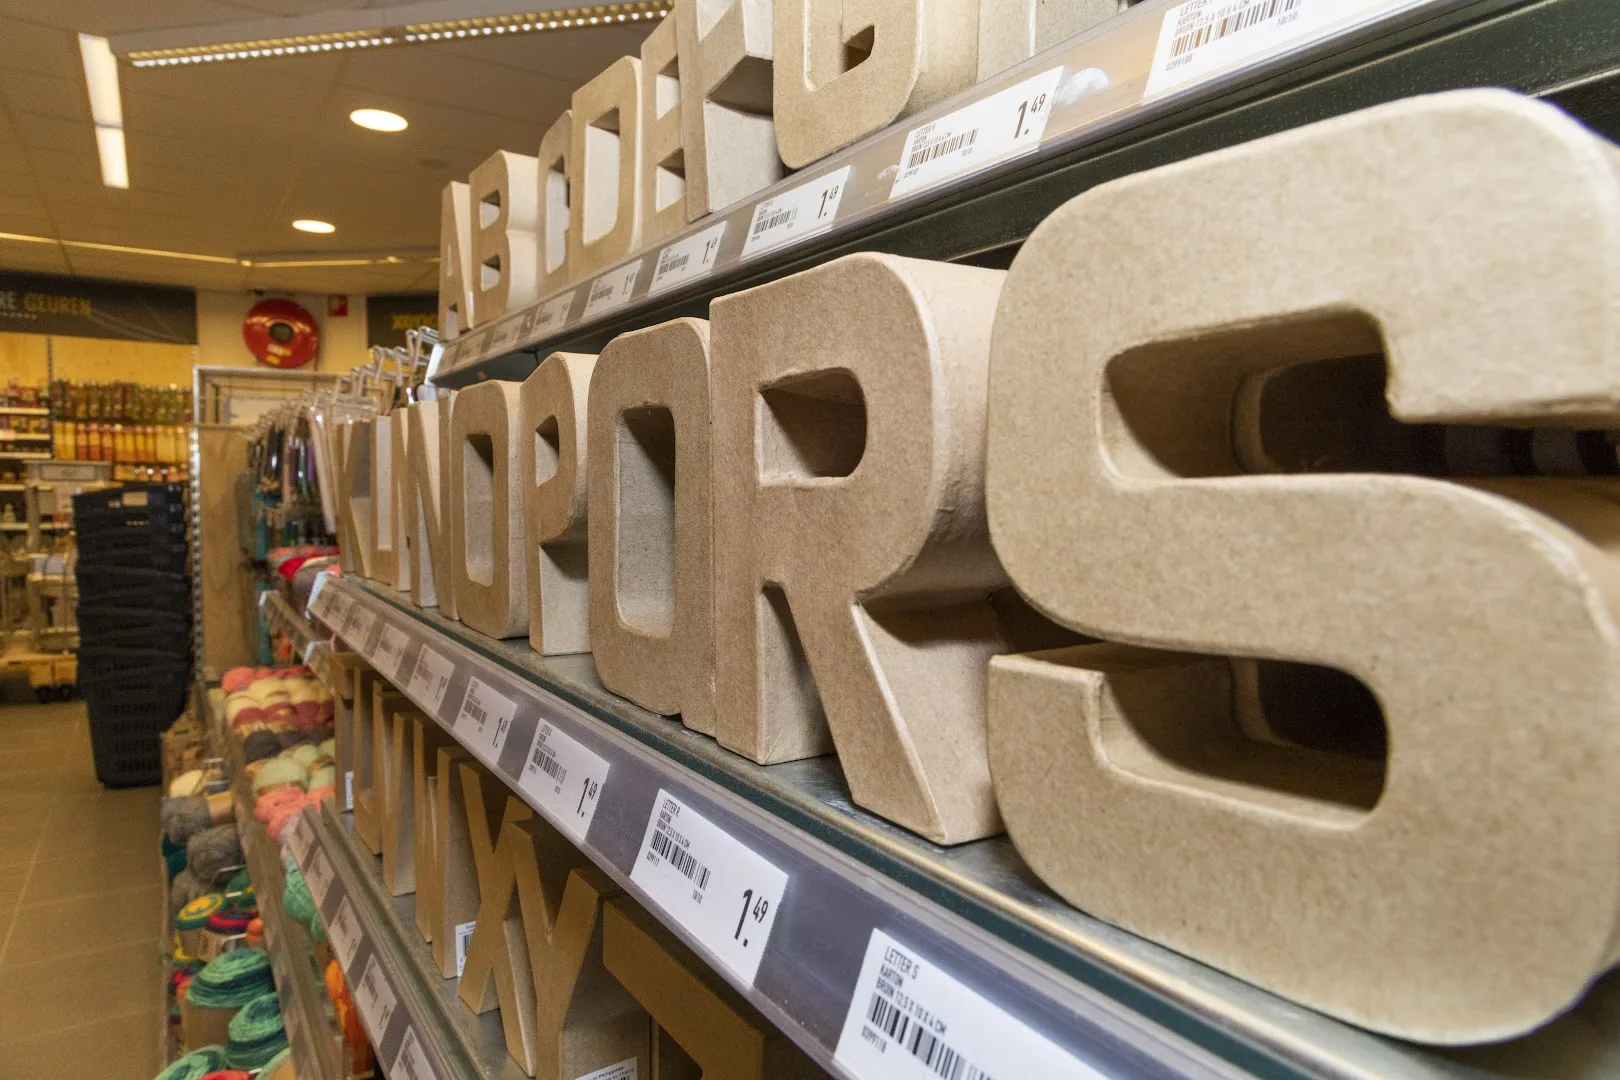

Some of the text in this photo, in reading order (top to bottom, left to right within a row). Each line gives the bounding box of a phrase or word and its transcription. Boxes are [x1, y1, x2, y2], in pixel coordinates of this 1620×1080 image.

[1174, 22, 1195, 36] BRUIN
[1211, 12, 1216, 20] X
[1217, 9, 1226, 19] 10
[1177, 9, 1202, 26] KARTON
[1276, 11, 1298, 27] 10/10
[1014, 93, 1046, 139] 1.49
[915, 125, 932, 138] LETTER
[818, 185, 839, 219] 1.49
[709, 252, 950, 845] R
[577, 777, 598, 817] 1.49
[663, 798, 681, 817] LETTER R
[659, 809, 671, 824] KARTON
[684, 838, 690, 849] CM
[692, 889, 703, 904] 10/10
[734, 888, 769, 947] 1.49
[880, 963, 904, 988] KARTON
[884, 945, 920, 980] LETTER S
[876, 976, 895, 998] BRUIN
[908, 1000, 914, 1012] X
[915, 1003, 923, 1019] 10
[934, 1019, 947, 1036] CM
